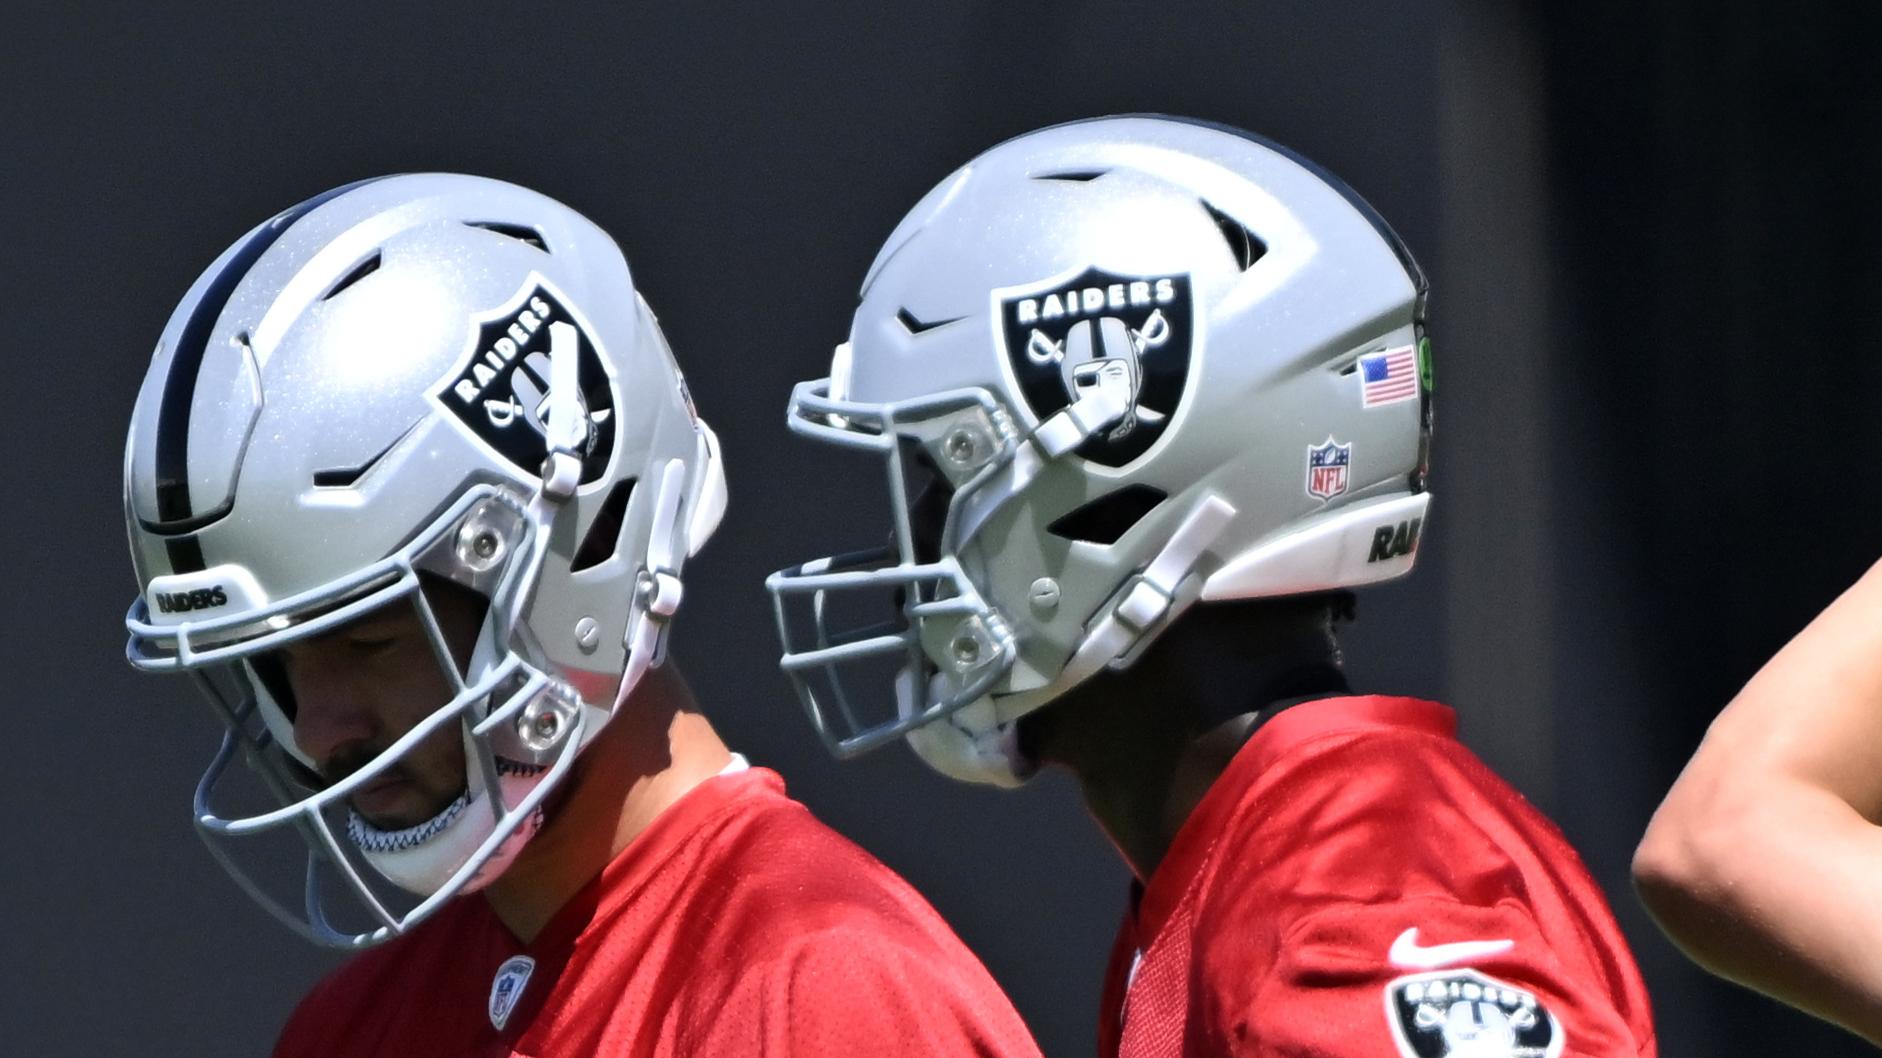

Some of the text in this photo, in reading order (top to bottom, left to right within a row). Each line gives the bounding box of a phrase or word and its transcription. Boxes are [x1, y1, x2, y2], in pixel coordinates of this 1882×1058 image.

[1018, 278, 1174, 324] RAIDERS
[454, 296, 550, 403] RAIDERS
[1312, 467, 1344, 493] NFL
[1405, 980, 1537, 1009] RAIDERS
